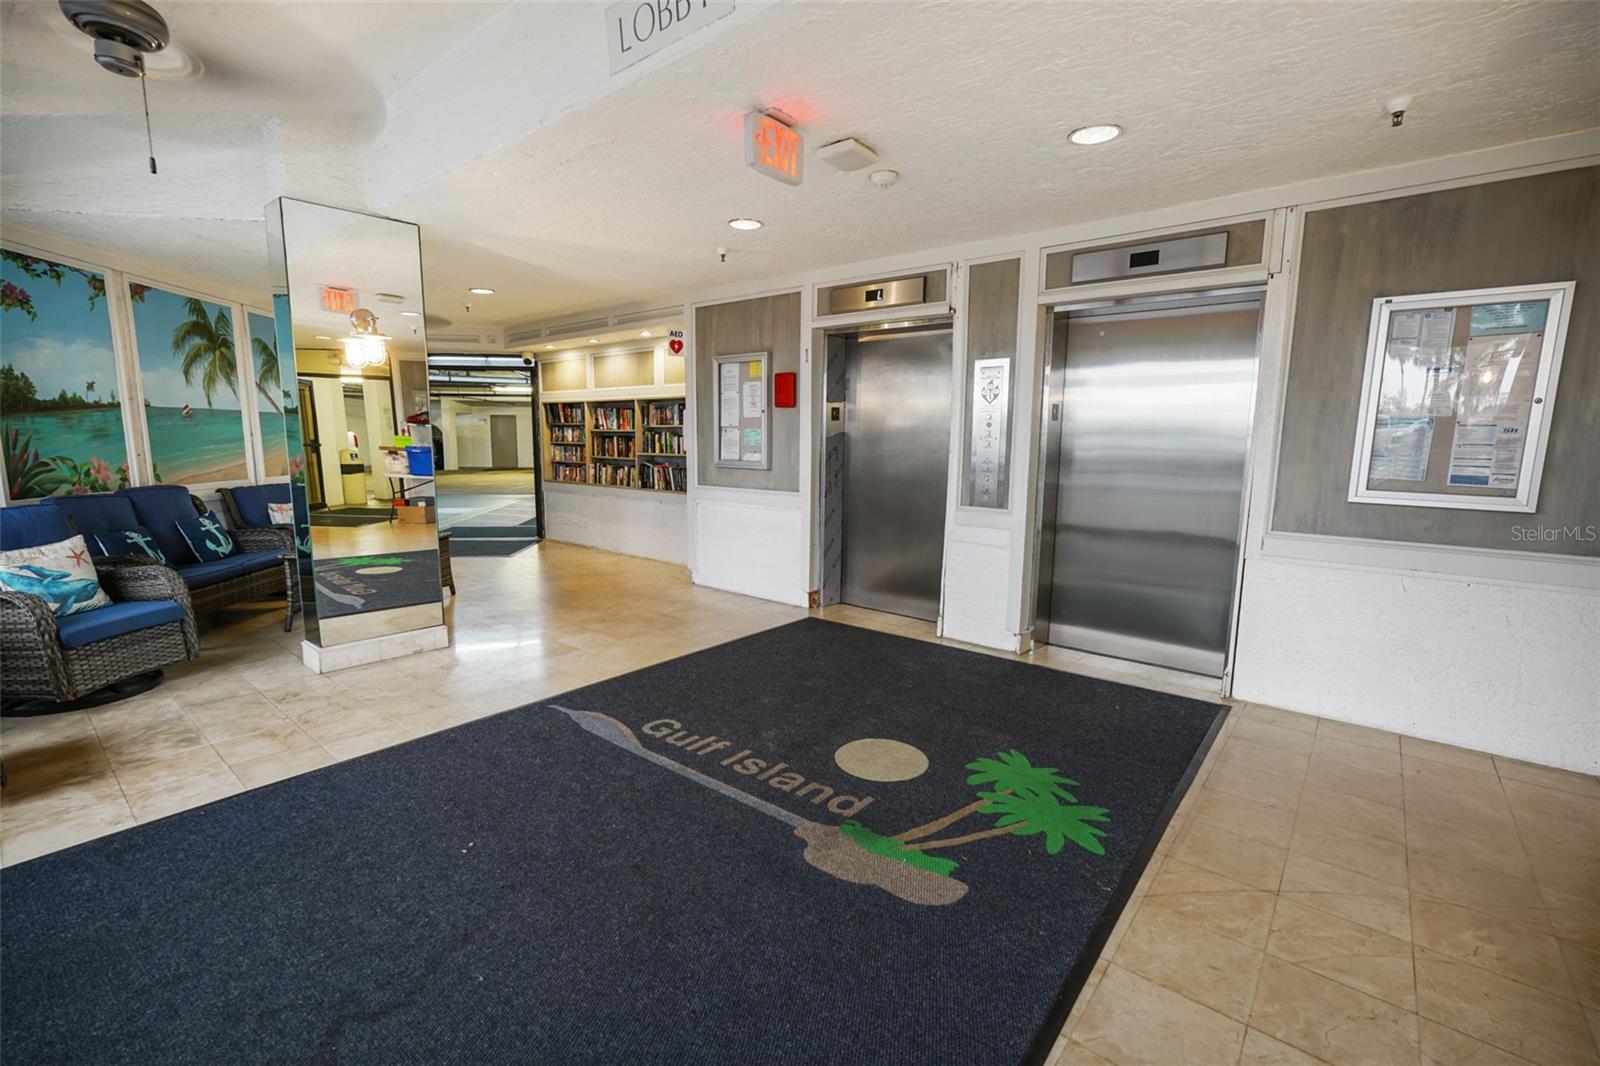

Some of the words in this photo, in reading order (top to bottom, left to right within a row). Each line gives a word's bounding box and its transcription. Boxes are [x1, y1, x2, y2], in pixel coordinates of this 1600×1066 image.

[618, 0, 707, 53] LOBB
[761, 117, 801, 177] EXIT
[669, 330, 684, 338] AED
[641, 718, 733, 756] Gulf
[719, 749, 876, 818] Island
